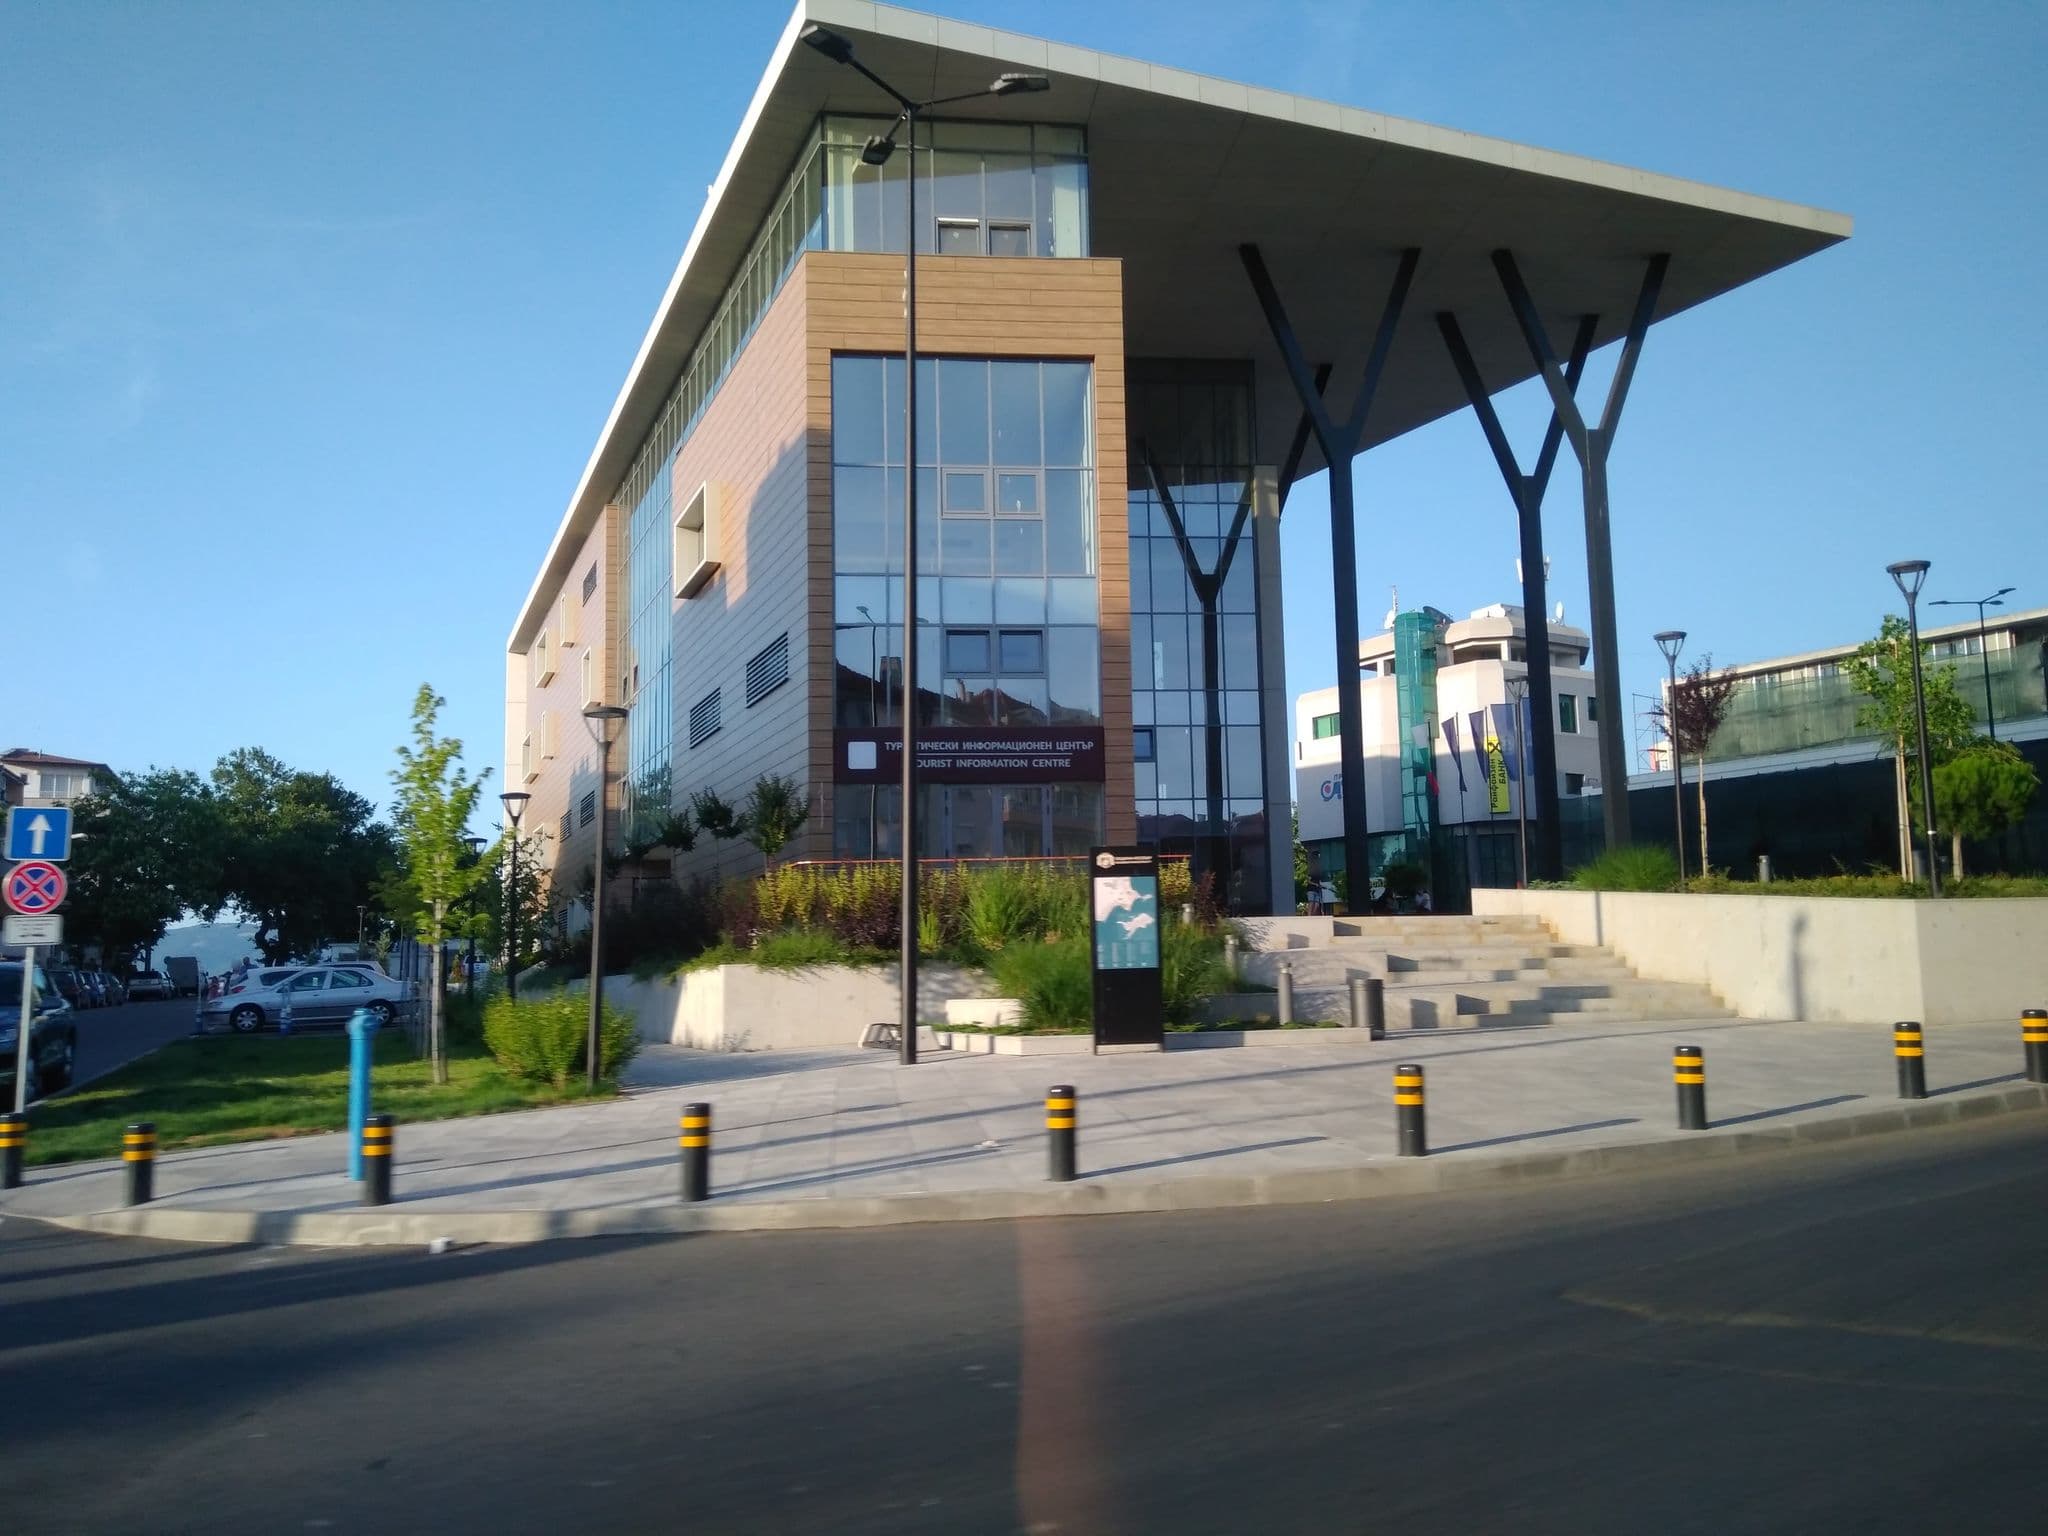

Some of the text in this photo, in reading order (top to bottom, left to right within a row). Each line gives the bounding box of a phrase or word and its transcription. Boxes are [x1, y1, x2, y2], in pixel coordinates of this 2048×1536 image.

[884, 741, 1094, 751] ТУРТИЧЕСКИ ИНФОРМАЦИОНЕН ЦЕНТЪР
[916, 759, 1071, 768] OURIST INFORMATION CENTRE
[1498, 759, 1507, 785] БАНК
